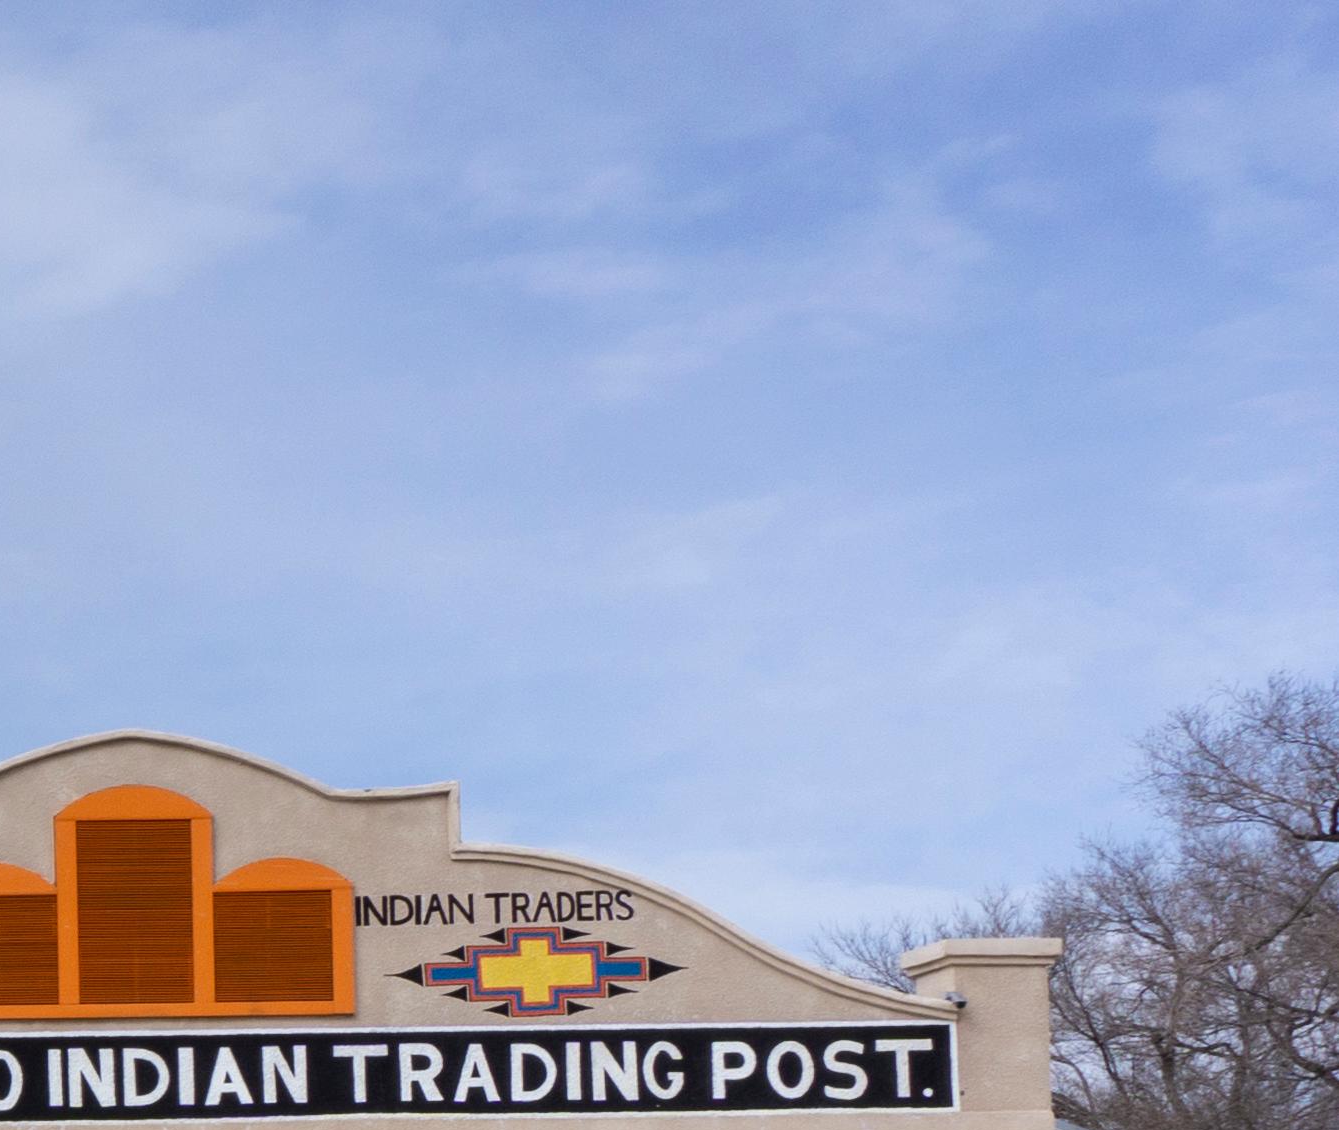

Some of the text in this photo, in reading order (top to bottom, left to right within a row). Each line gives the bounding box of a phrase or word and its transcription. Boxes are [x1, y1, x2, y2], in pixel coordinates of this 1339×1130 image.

[355, 889, 634, 927] INDIAN TRADERS
[48, 1045, 308, 1108] INDIAN
[333, 1040, 685, 1103] TRADING
[711, 1039, 935, 1100] POST.
